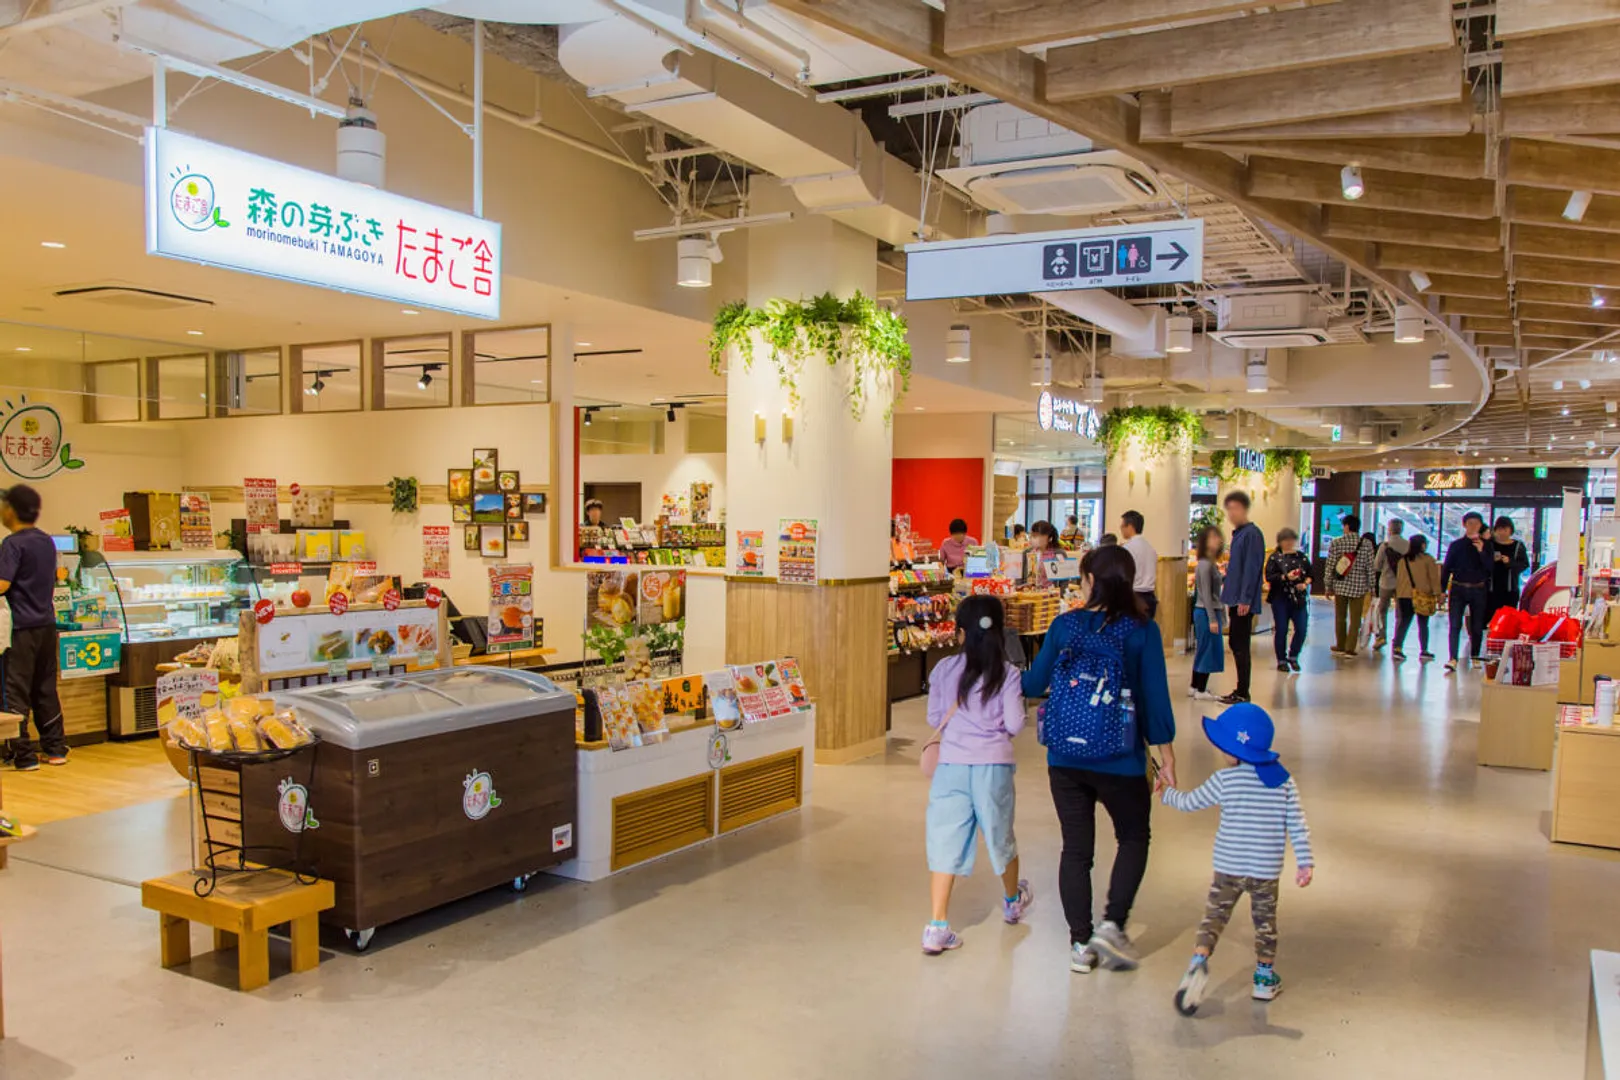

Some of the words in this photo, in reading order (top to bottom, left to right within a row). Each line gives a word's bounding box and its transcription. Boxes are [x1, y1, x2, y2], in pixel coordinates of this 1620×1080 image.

[247, 187, 384, 247] 森の芽ぶき
[246, 226, 319, 252] morinomebuki
[322, 240, 384, 266] TAMAGOYA
[396, 219, 494, 296] たまご舎
[5, 435, 53, 458] たまご舎
